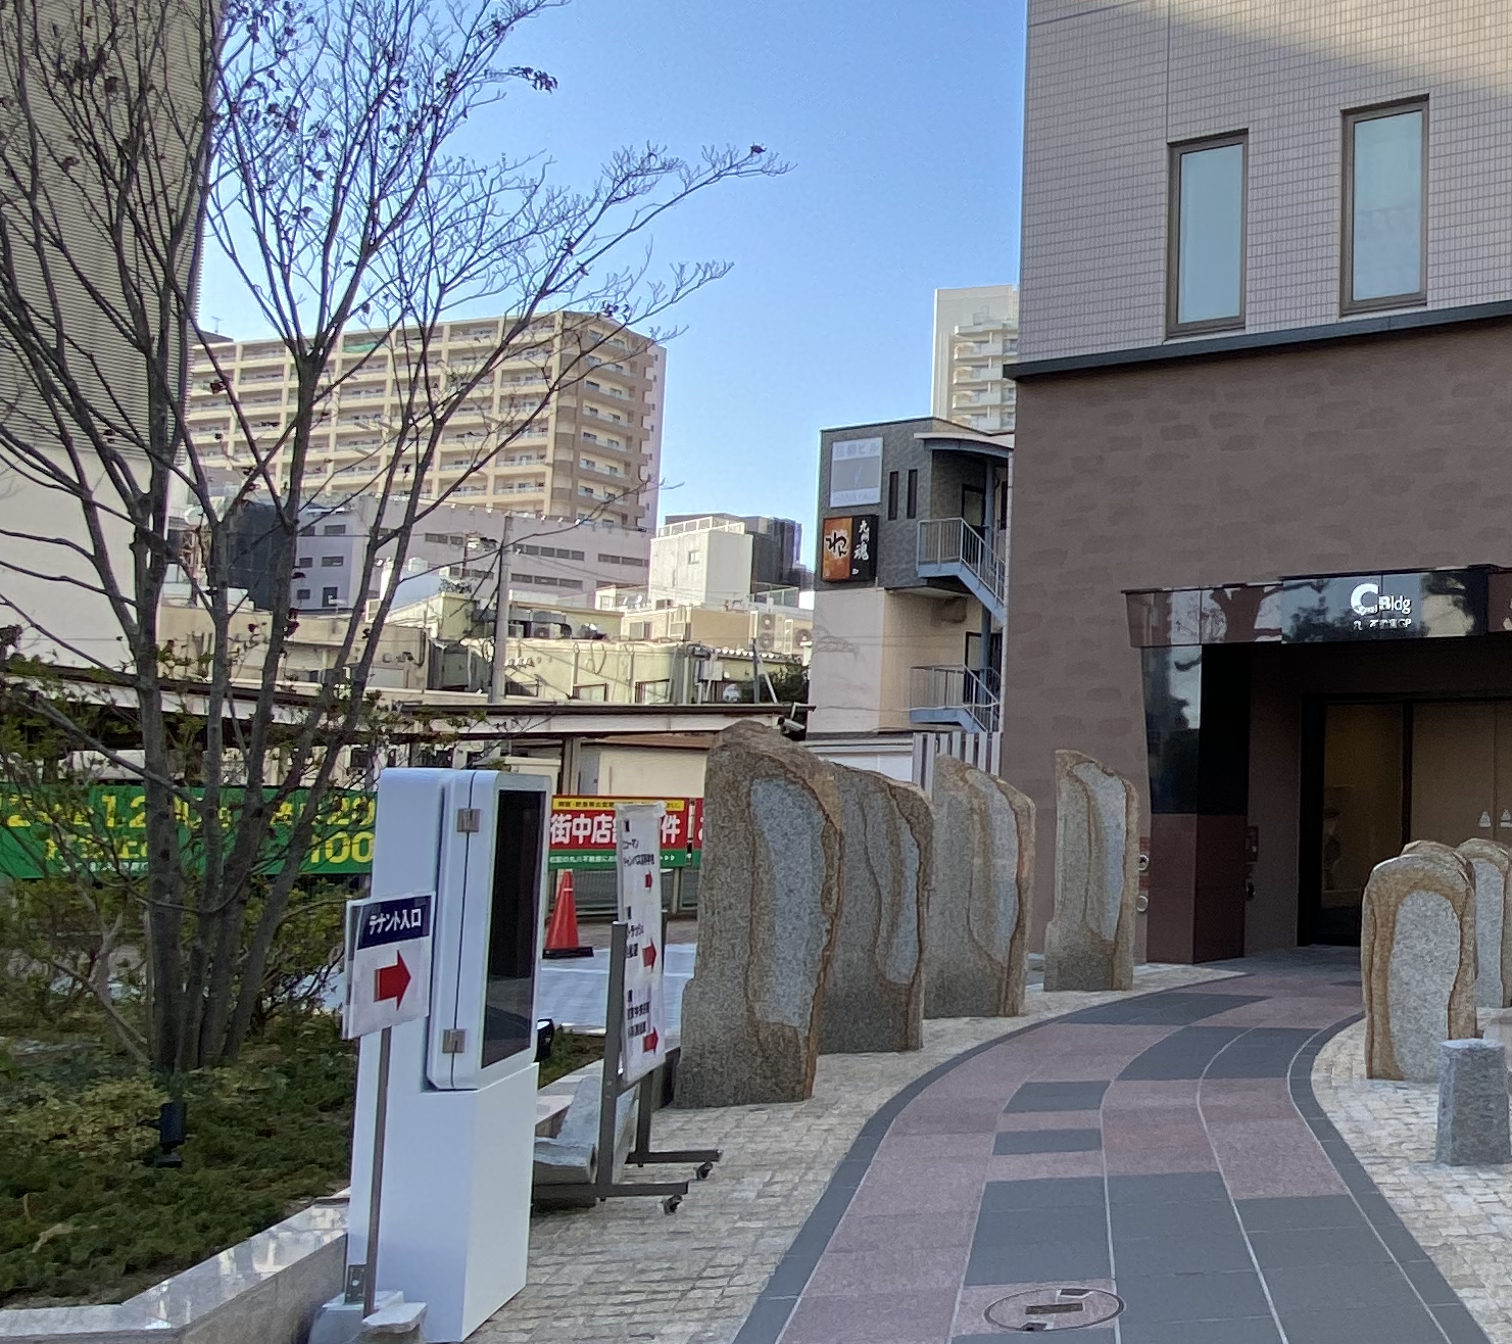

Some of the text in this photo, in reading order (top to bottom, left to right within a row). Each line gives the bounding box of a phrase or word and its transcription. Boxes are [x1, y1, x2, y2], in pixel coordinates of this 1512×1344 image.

[368, 908, 422, 935] テナント入口
